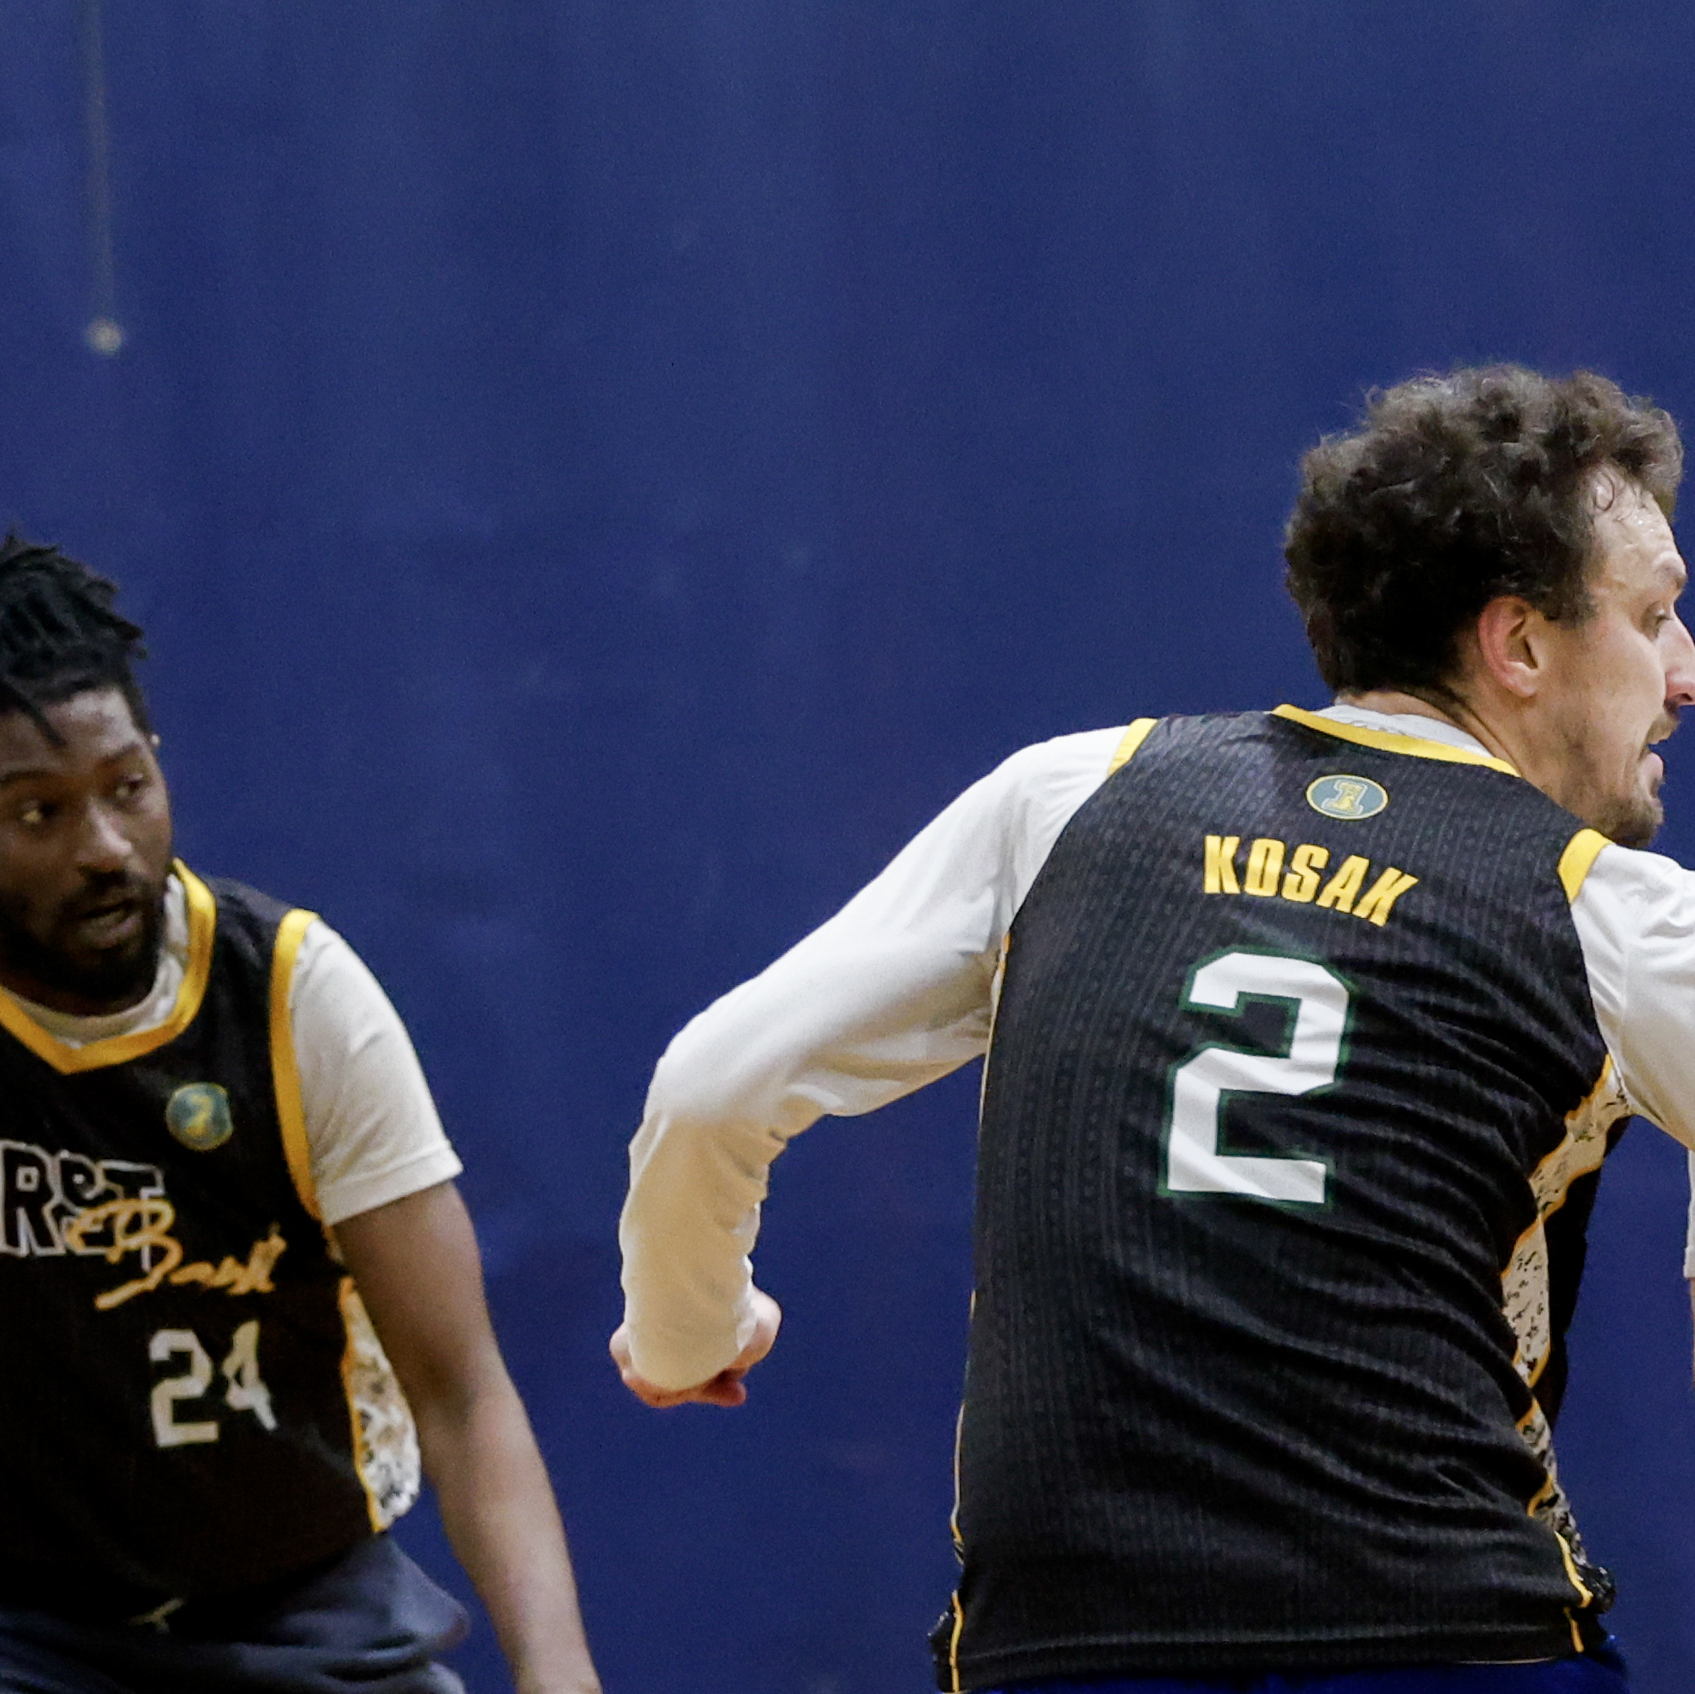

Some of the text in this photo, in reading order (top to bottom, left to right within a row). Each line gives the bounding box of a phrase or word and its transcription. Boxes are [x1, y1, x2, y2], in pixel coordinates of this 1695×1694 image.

[1202, 834, 1419, 928] KOSAK
[1163, 948, 1352, 1206] 2
[148, 1319, 279, 1448] 24
